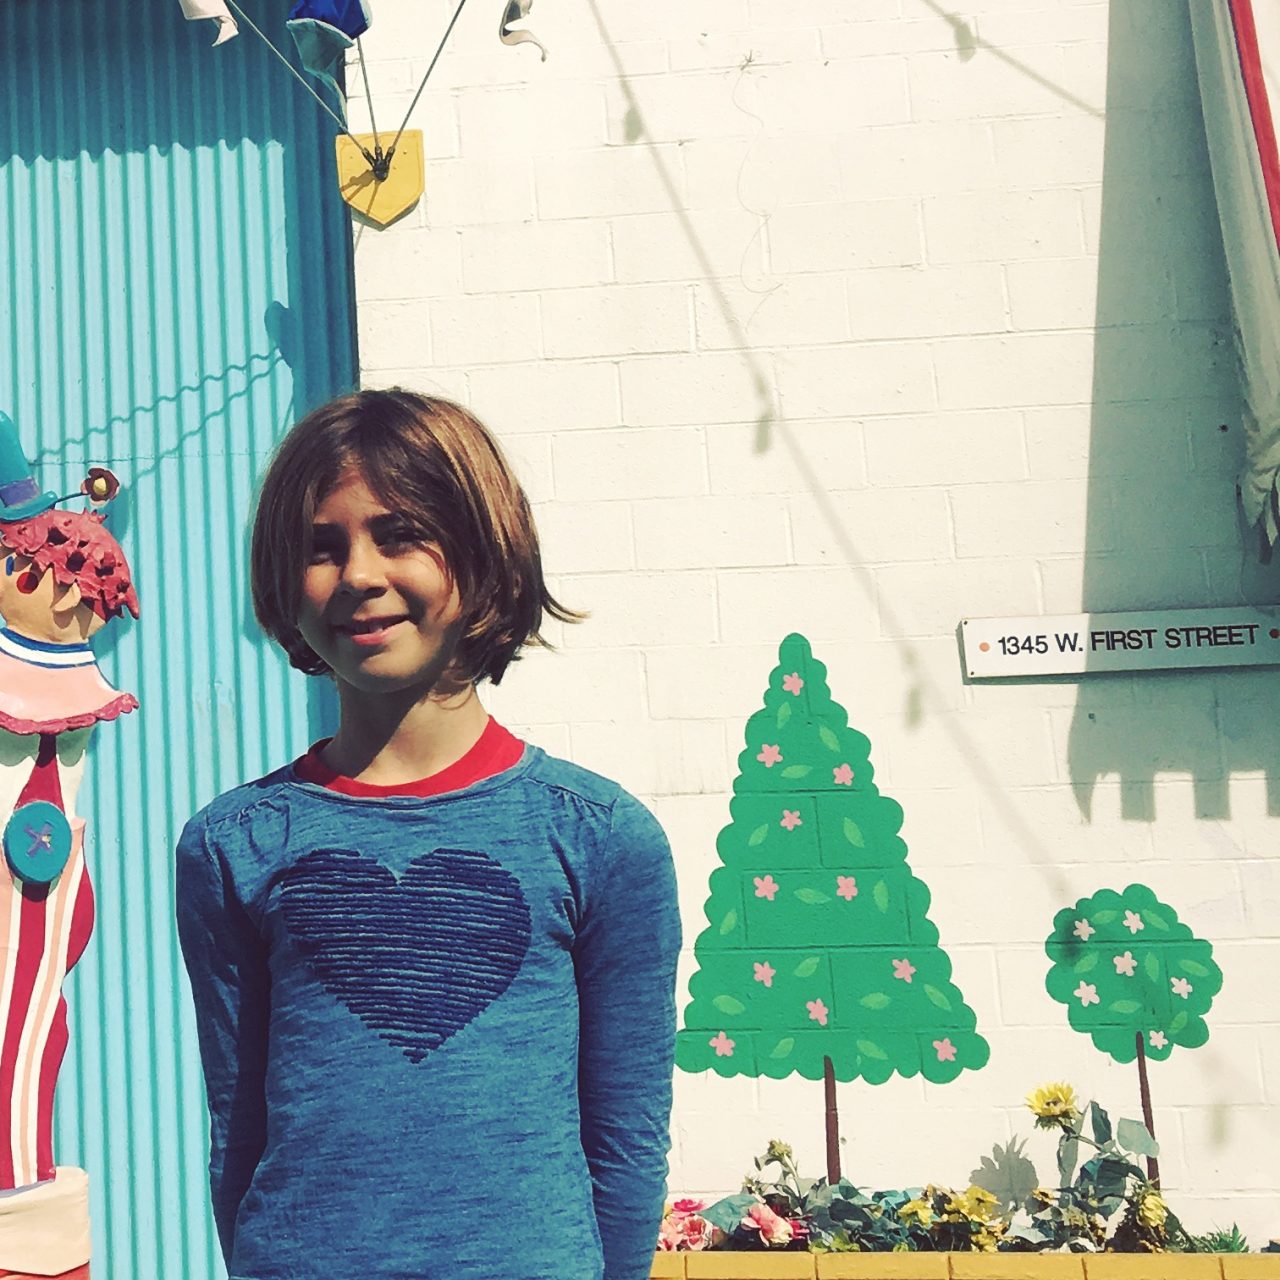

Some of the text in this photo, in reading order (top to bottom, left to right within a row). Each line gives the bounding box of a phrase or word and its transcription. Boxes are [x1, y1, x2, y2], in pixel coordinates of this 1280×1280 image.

[998, 624, 1261, 655] 1345 W. FIRST STREET
